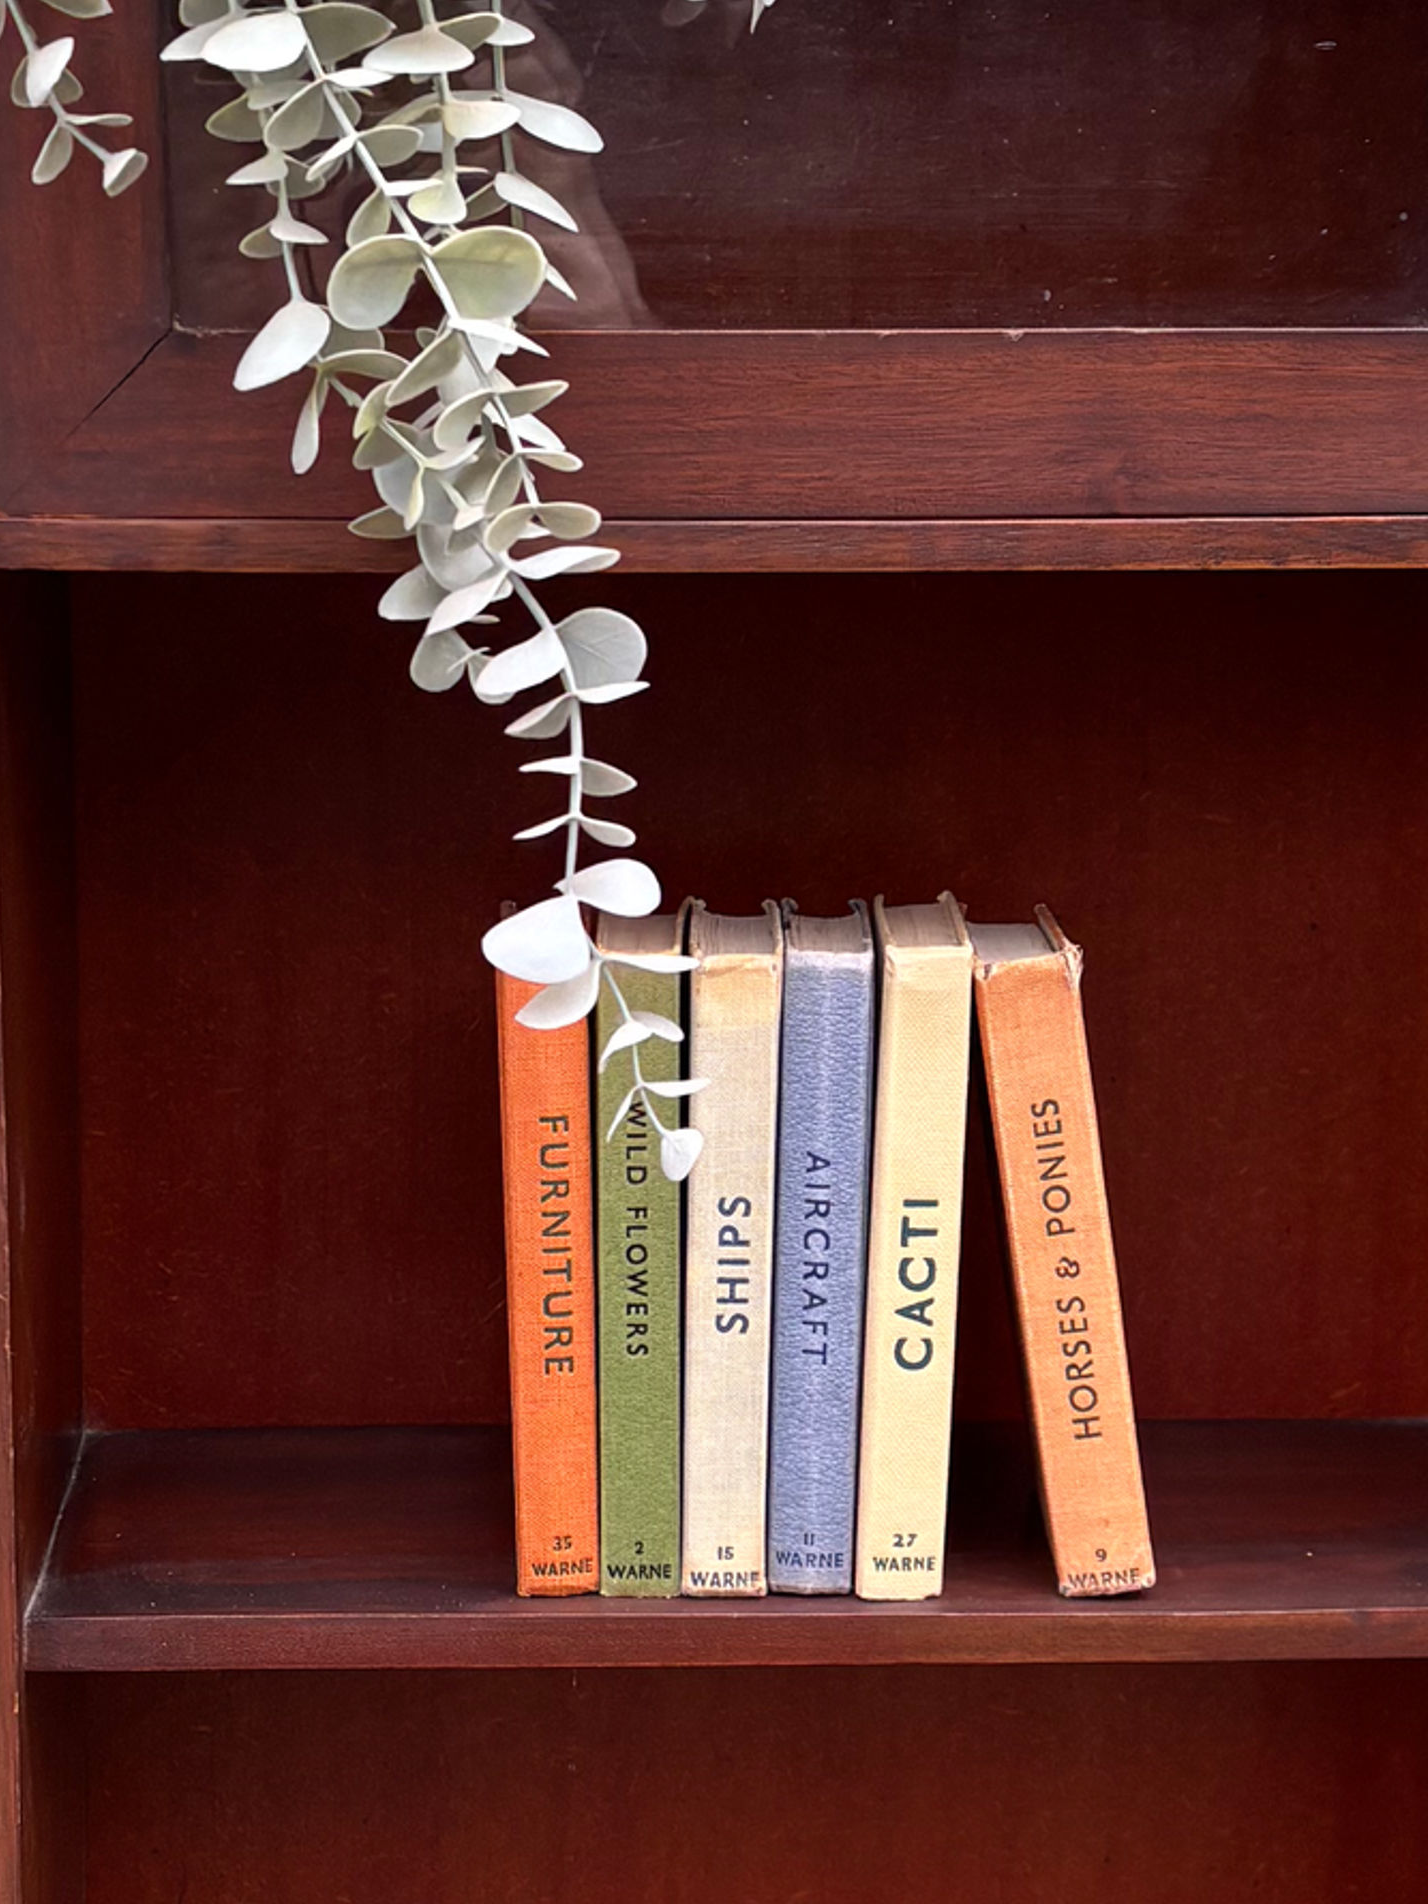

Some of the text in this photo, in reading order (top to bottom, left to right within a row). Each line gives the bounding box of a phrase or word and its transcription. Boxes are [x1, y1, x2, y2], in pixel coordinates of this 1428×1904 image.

[625, 1101, 649, 1359] WILD FLOWERS
[538, 1114, 574, 1376] FURNITURE
[715, 1195, 752, 1336] SHIPS
[801, 1151, 832, 1366] AIRCRAFT
[1030, 1097, 1102, 1441] HORSES & PONIES
[894, 1198, 940, 1371] CACTI
[553, 1535, 573, 1551] 35
[635, 1542, 645, 1555] 2
[892, 1534, 918, 1548] 27
[717, 1546, 735, 1561] 15
[775, 1550, 845, 1570] WARNE
[1095, 1548, 1108, 1562] 9
[531, 1557, 594, 1577] WARNE
[606, 1564, 672, 1580] WARNE
[873, 1556, 936, 1572] WARNE
[690, 1571, 760, 1589] WARNE
[1067, 1567, 1140, 1589] WARNE
